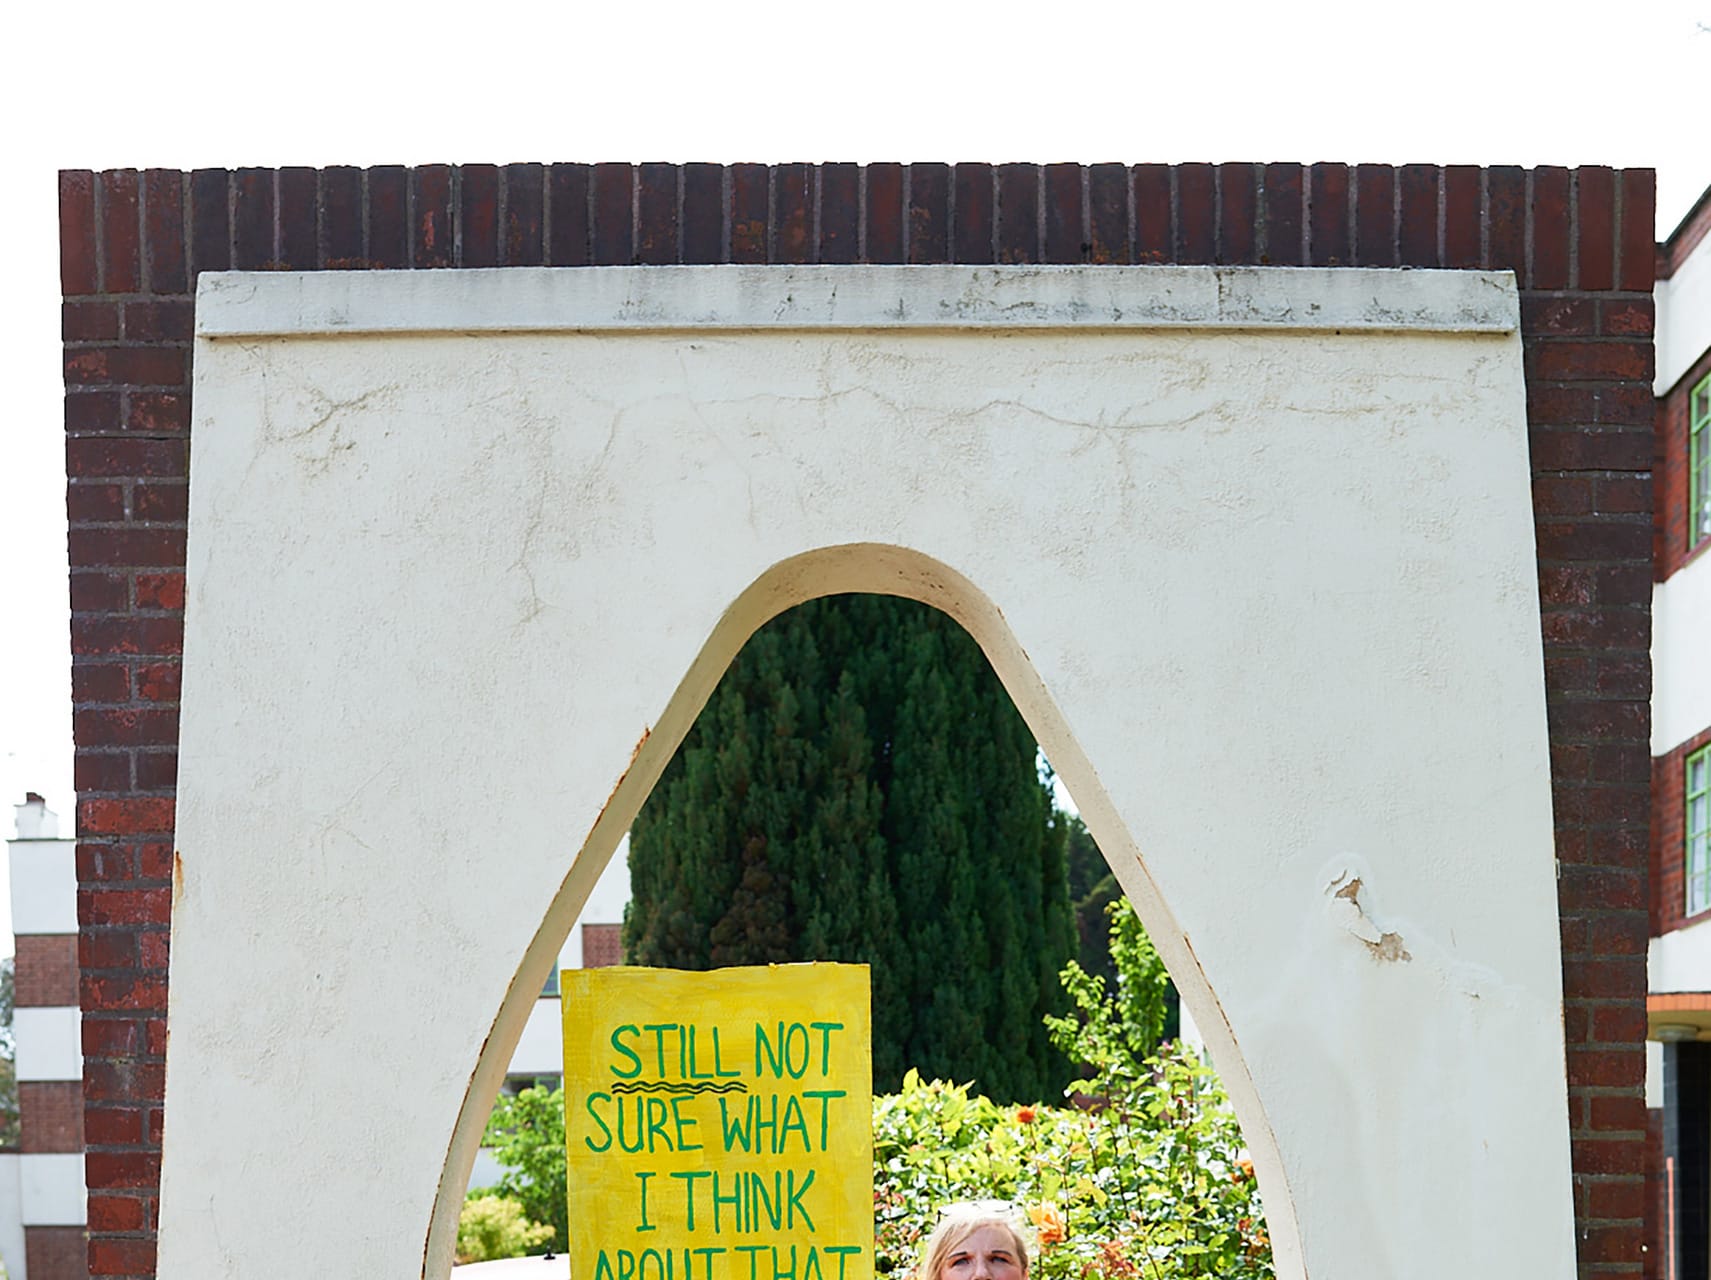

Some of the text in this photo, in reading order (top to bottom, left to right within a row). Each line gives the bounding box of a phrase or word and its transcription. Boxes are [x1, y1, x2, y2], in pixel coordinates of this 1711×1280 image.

[610, 1022, 845, 1080] STILL NOT
[586, 1090, 847, 1154] SURE WHAT
[635, 1170, 816, 1233] I THINK
